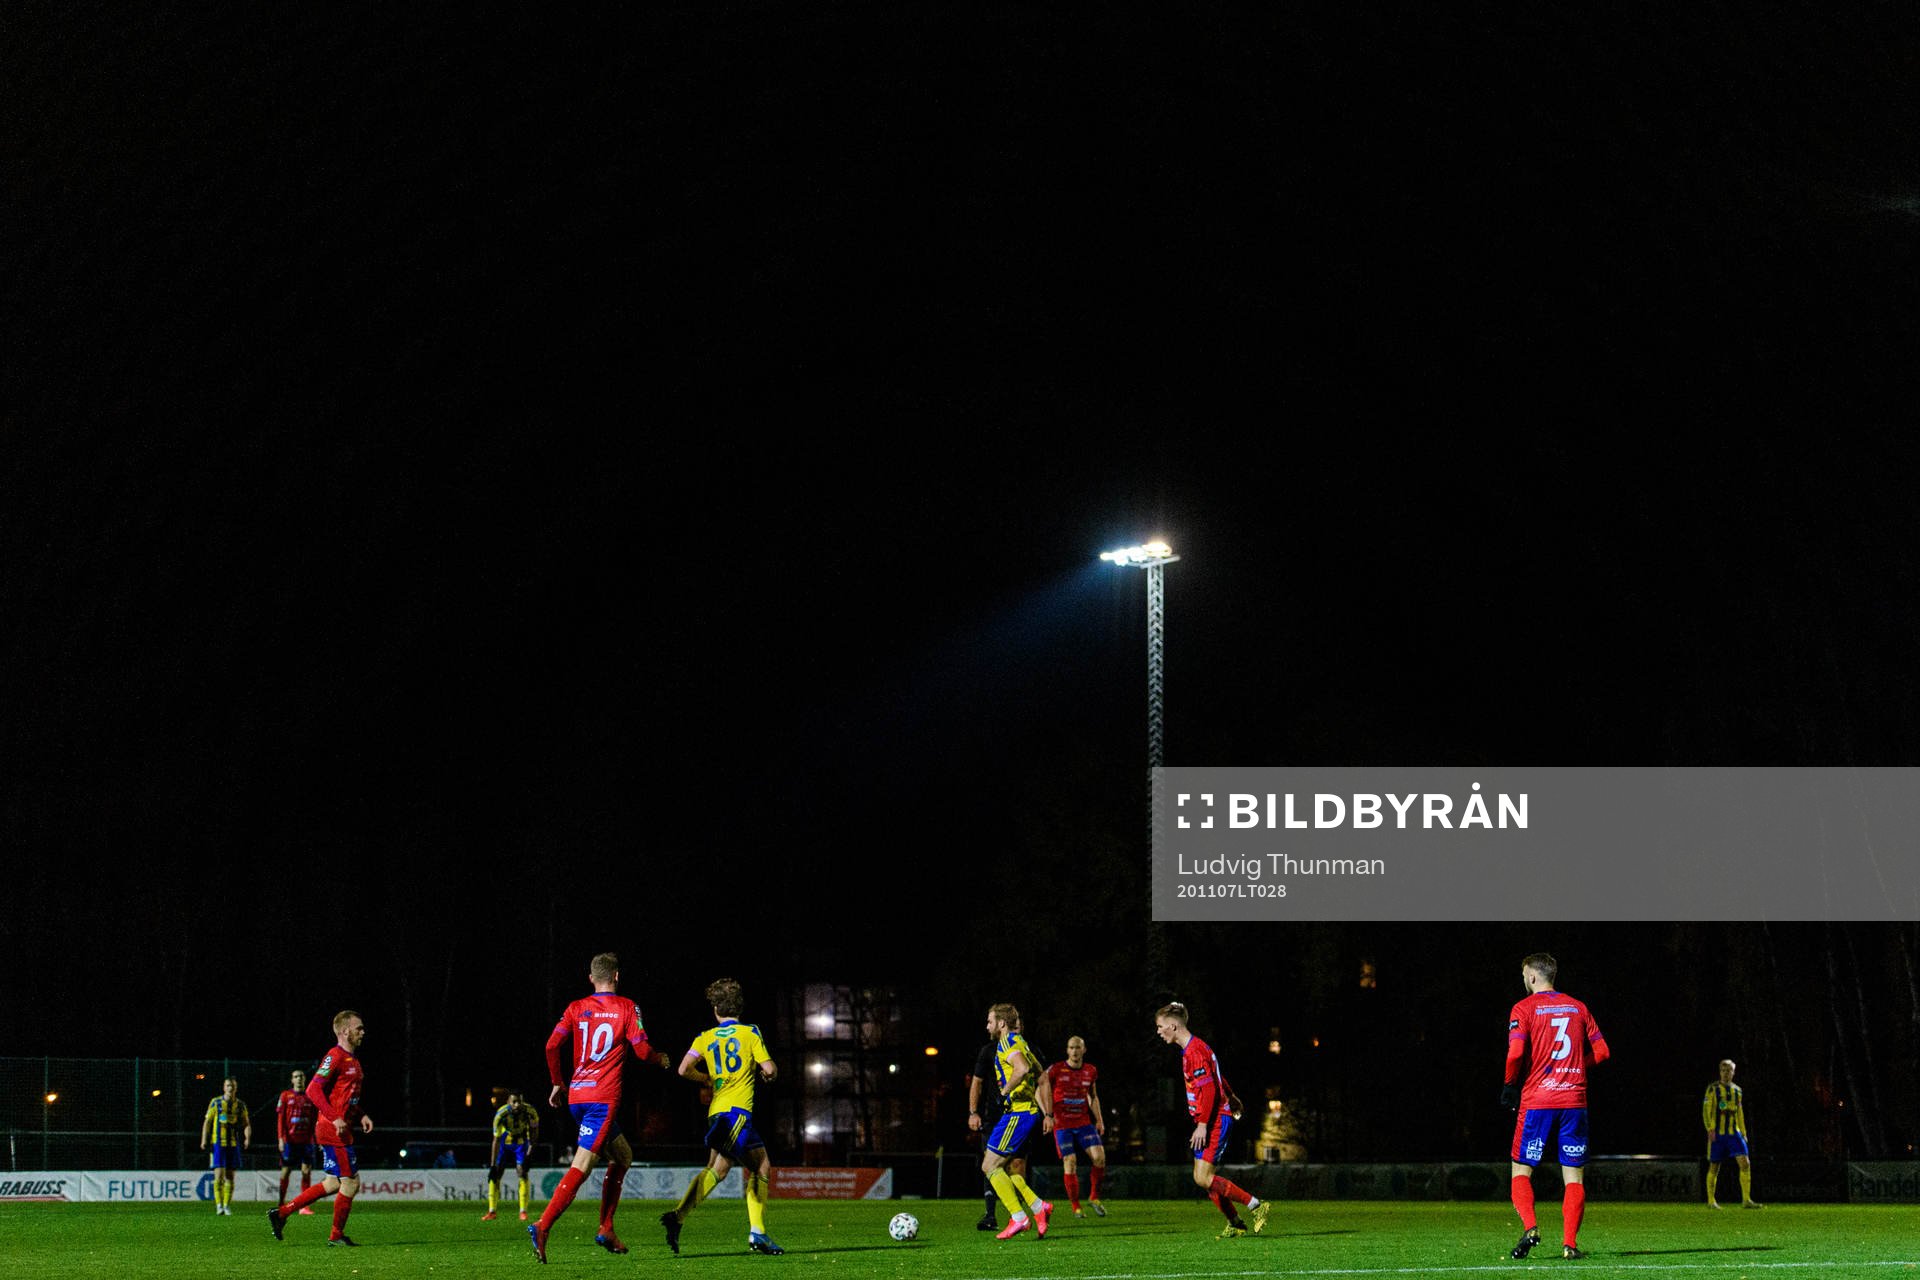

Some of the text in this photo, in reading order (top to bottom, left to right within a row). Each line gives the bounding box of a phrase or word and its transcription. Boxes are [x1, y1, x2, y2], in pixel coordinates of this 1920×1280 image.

[578, 1021, 614, 1063] 10
[707, 1037, 742, 1075] 18
[1551, 1017, 1572, 1060] 3
[108, 1180, 192, 1198] FUTURE
[360, 1181, 424, 1194] HARP
